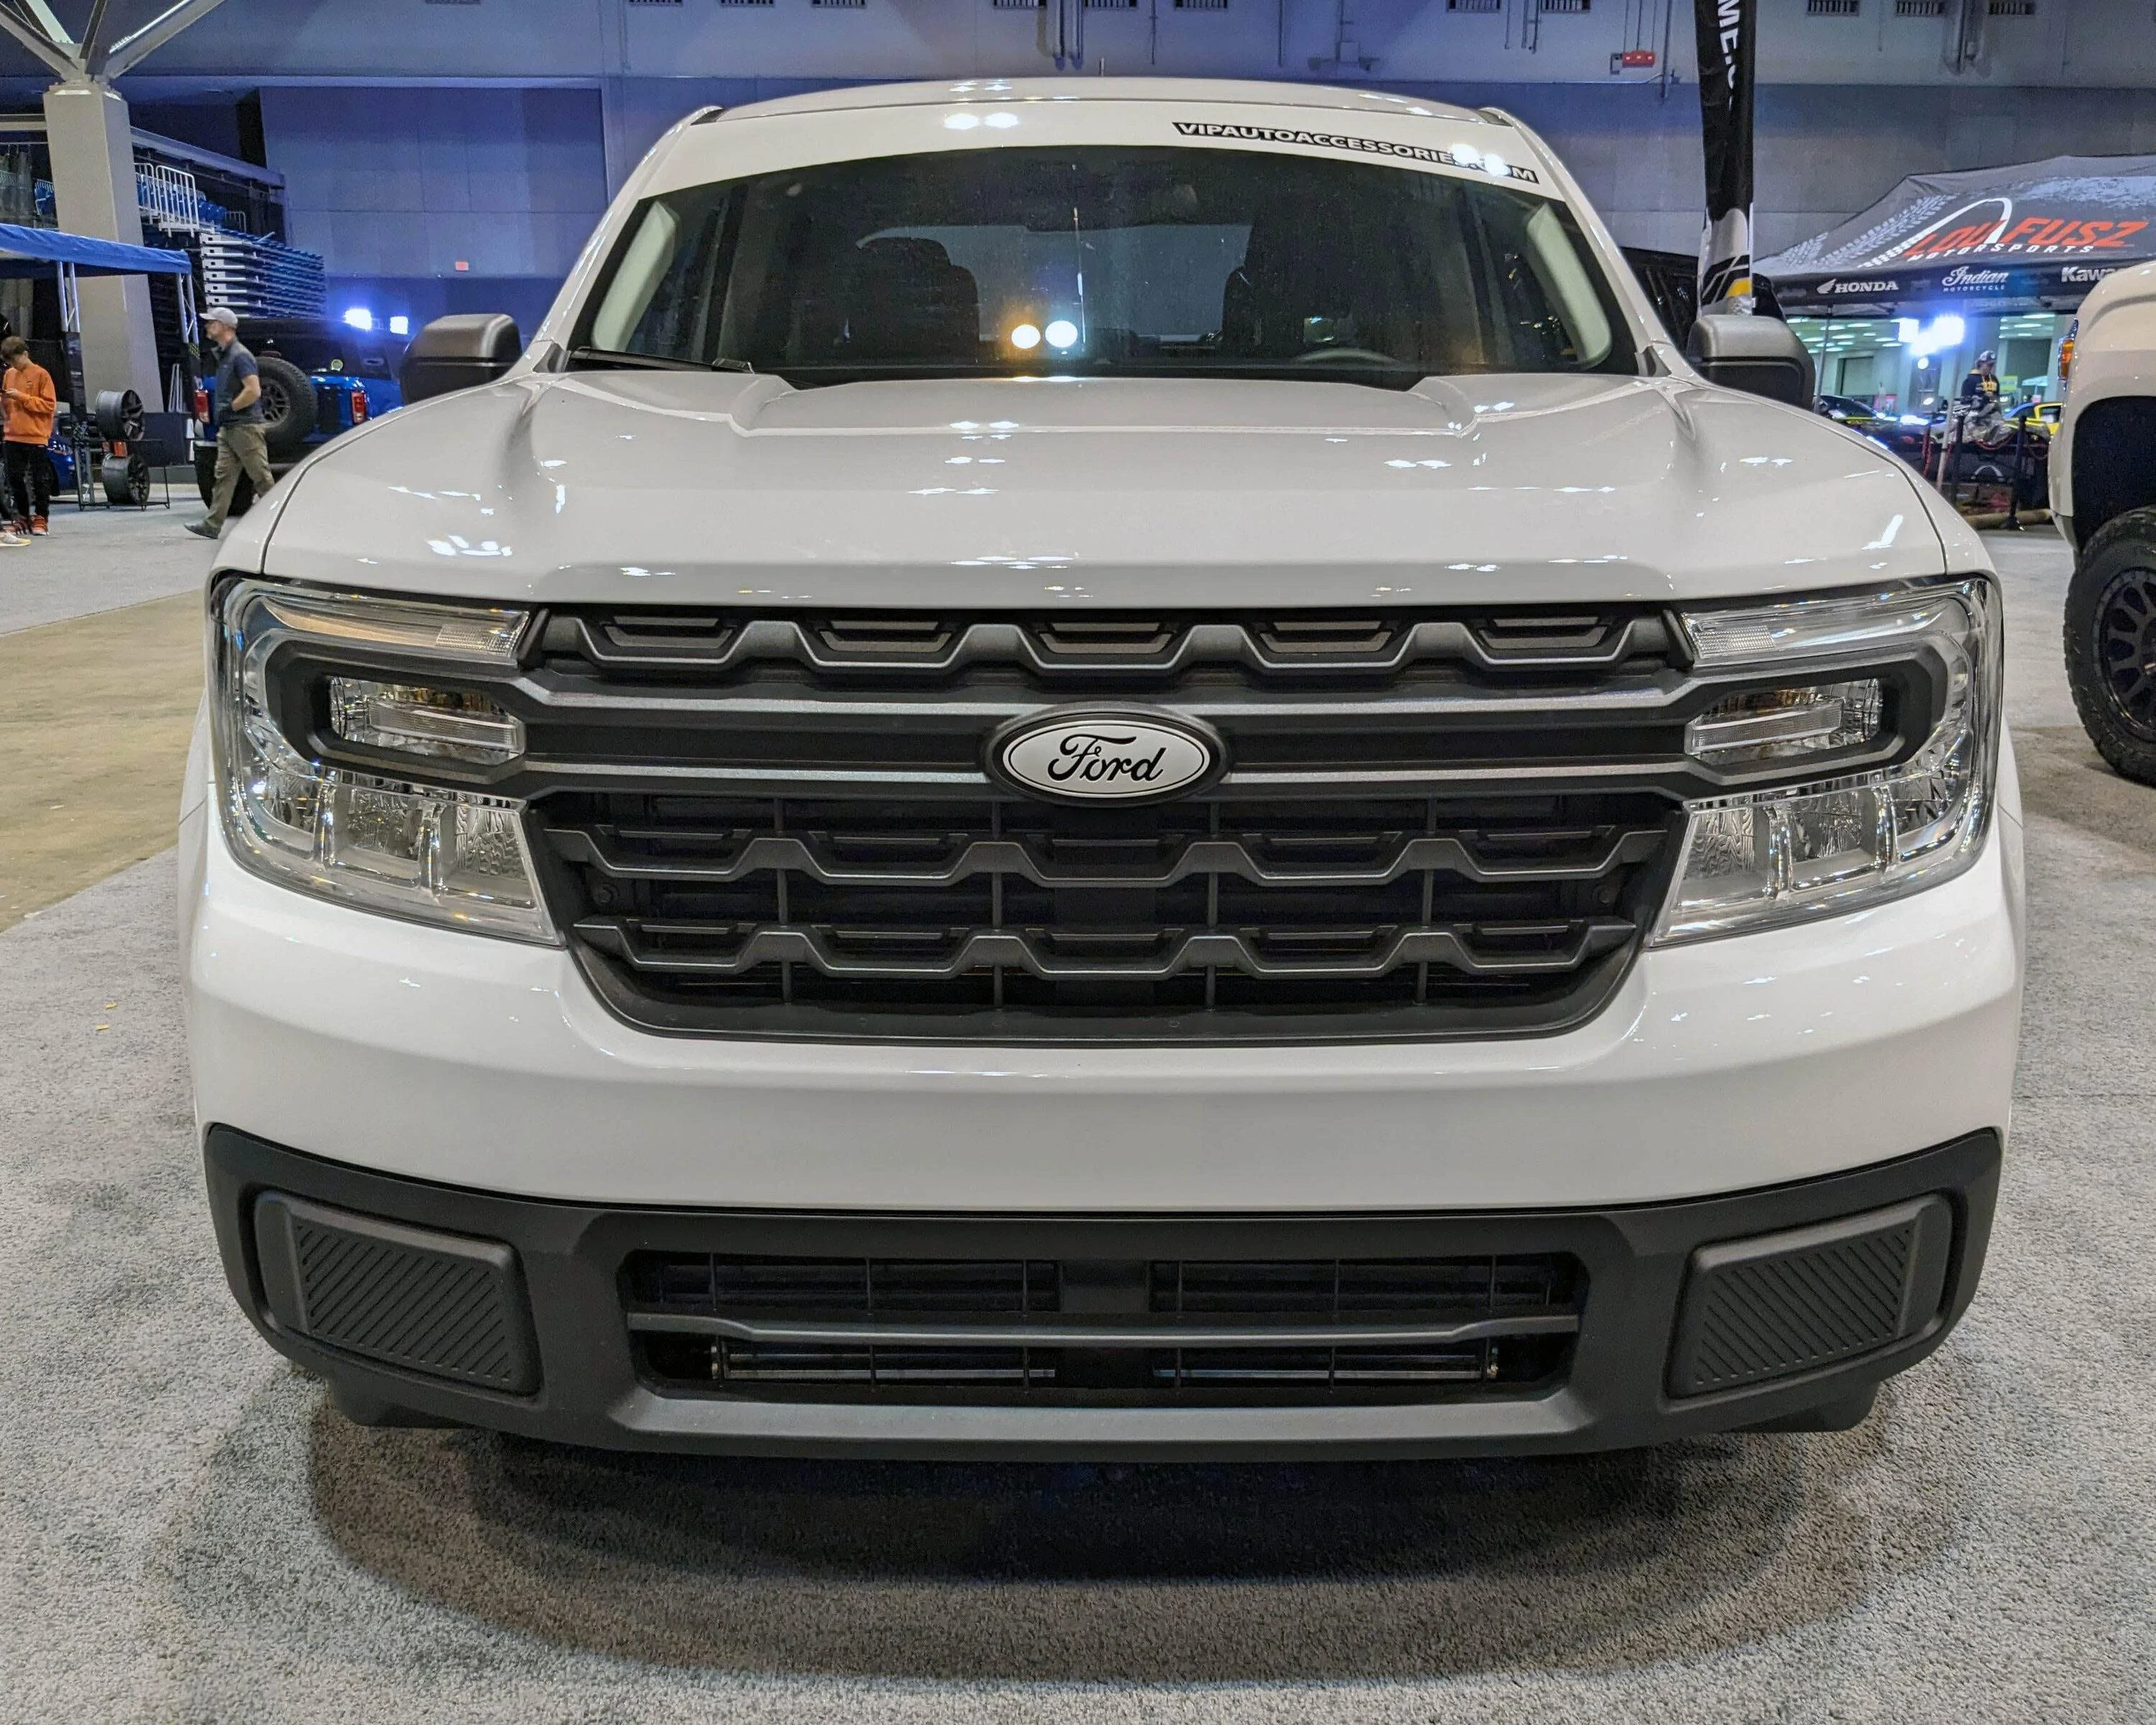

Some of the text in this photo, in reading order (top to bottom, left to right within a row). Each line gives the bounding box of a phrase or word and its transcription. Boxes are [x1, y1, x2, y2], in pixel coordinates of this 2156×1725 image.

[1903, 216, 2150, 257] LOU FUSZ
[1906, 244, 2094, 262] MOTORSPORTS
[1834, 280, 1899, 294] HONDA
[1941, 265, 2009, 287] Indian
[1047, 733, 1166, 781] Ford
